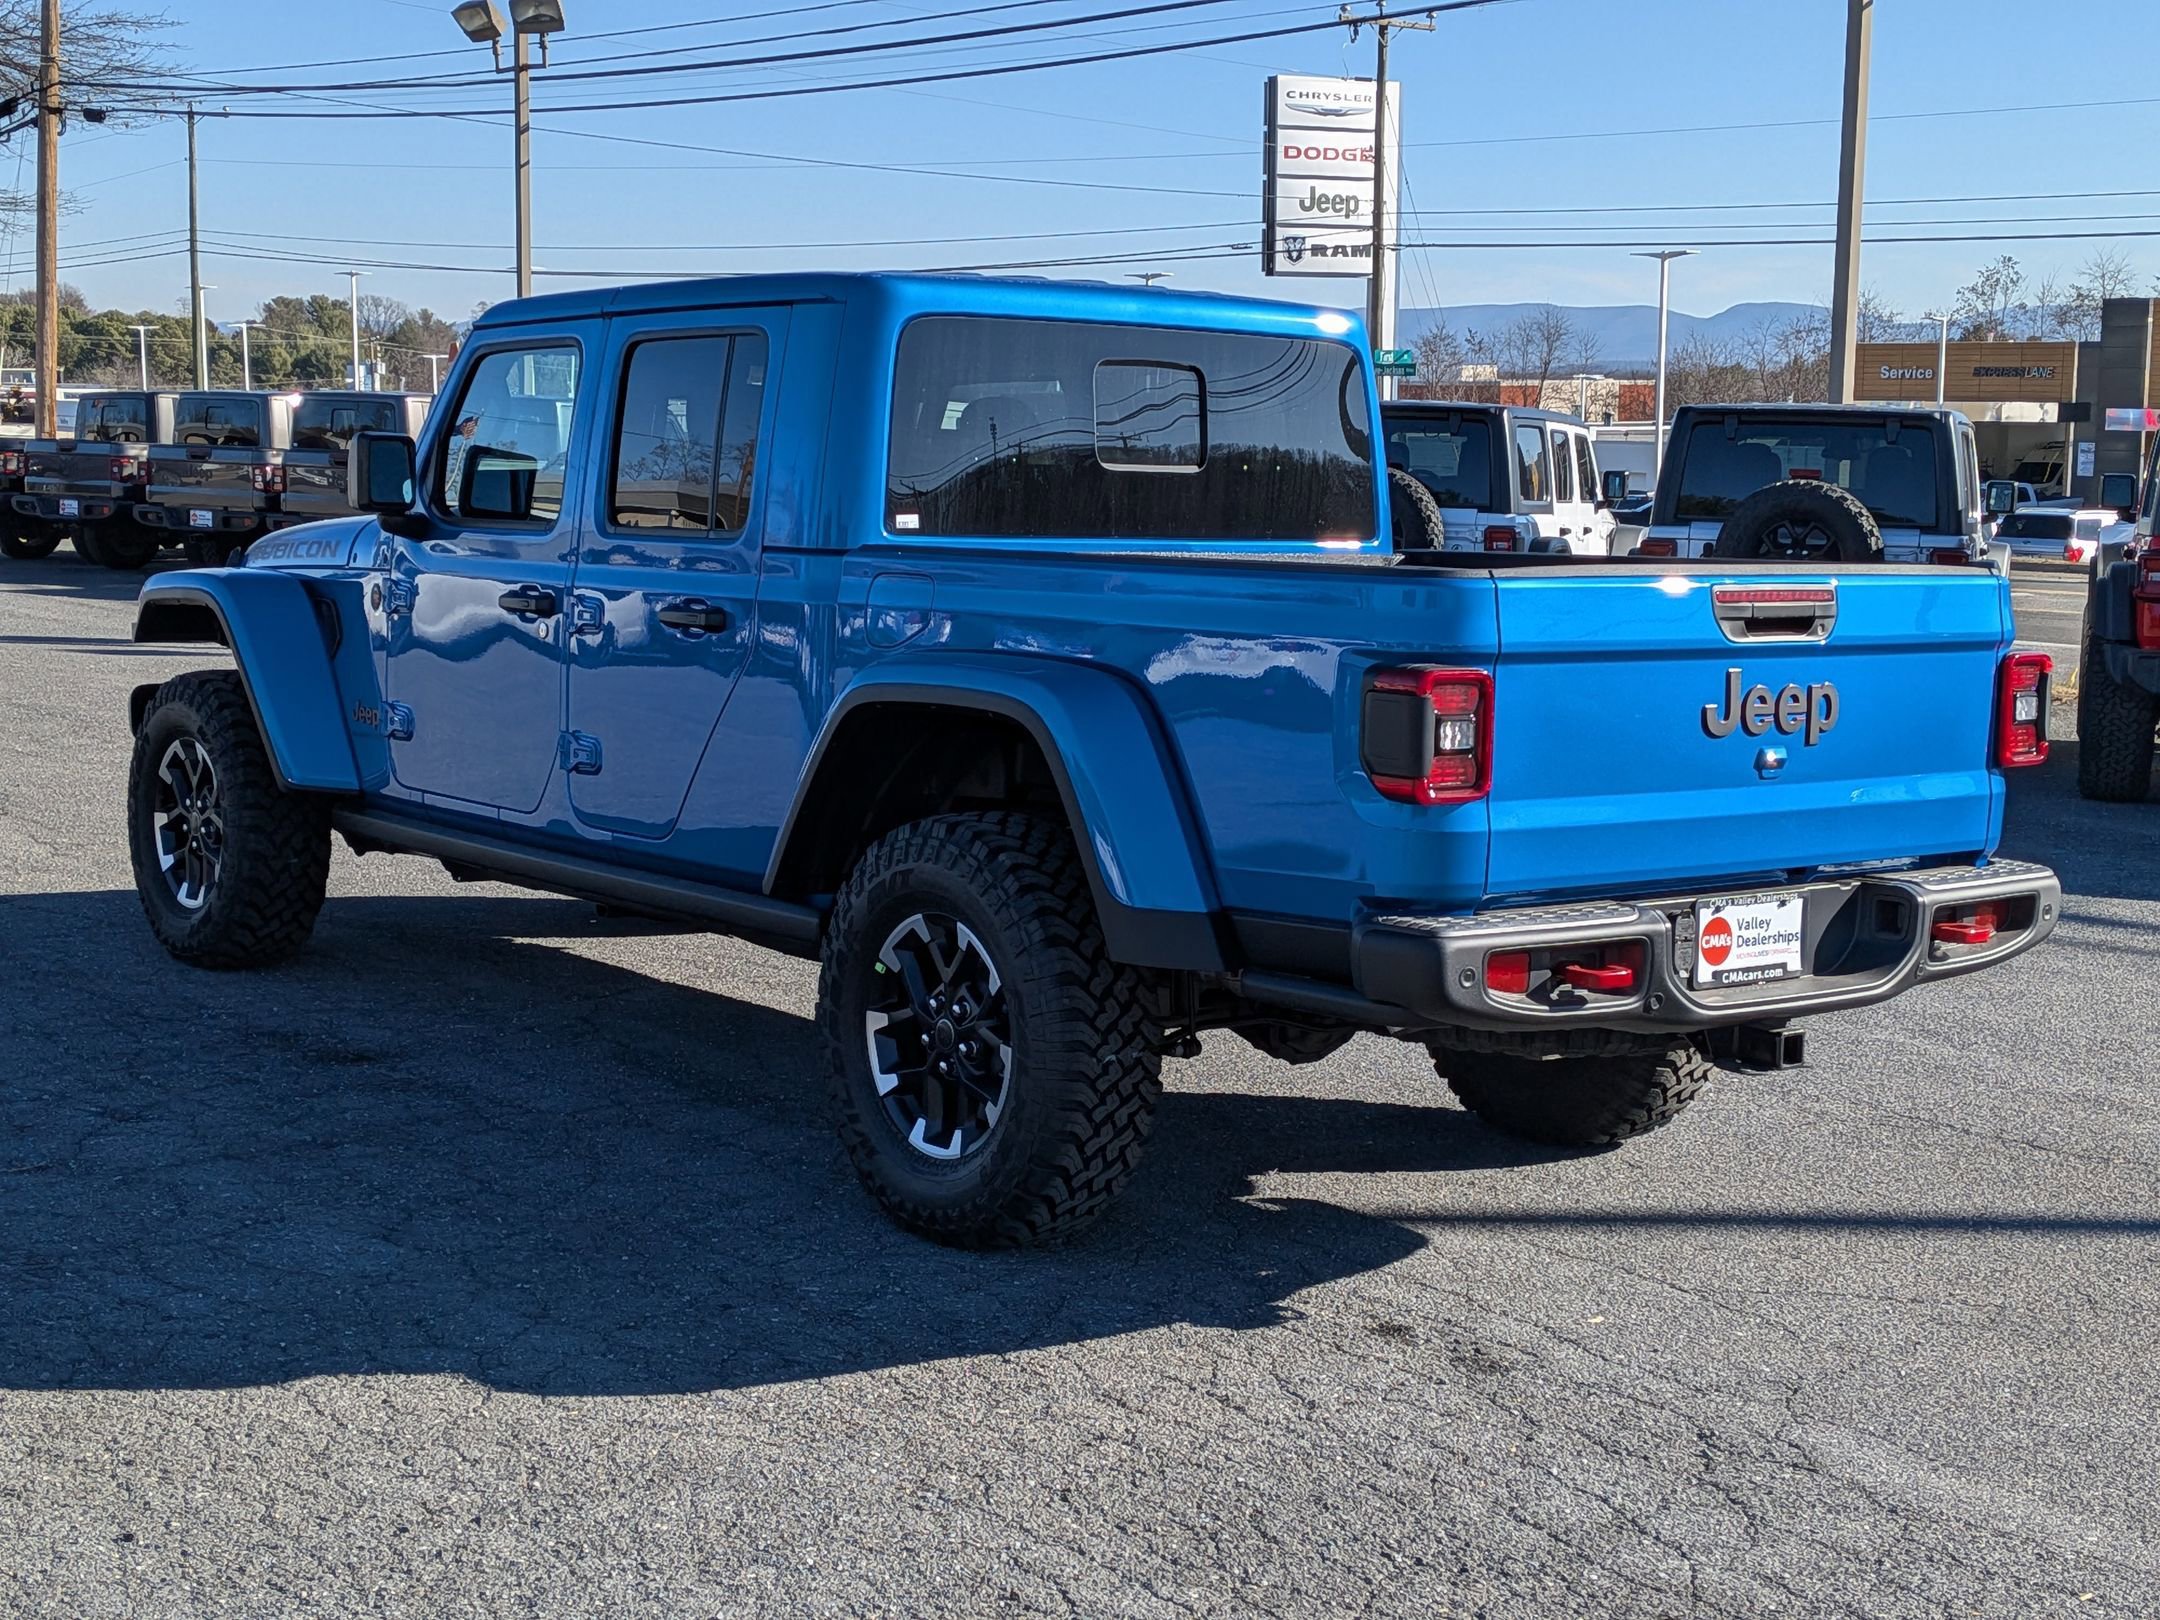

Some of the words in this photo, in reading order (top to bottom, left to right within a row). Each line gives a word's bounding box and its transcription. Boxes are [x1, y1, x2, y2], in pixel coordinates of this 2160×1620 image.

[1286, 90, 1372, 103] CHRYSLER
[1283, 145, 1375, 163] DODGE
[1299, 186, 1359, 219] Jeep
[1310, 243, 1371, 258] RAM
[1880, 365, 1934, 379] Service
[352, 700, 379, 728] Jeep
[1701, 667, 1839, 746] Jeep
[1736, 917, 1772, 932] Valley
[1702, 933, 1732, 949] CMA's
[1735, 930, 1800, 948] Dealerships
[1722, 967, 1784, 984] CMAcars.com
